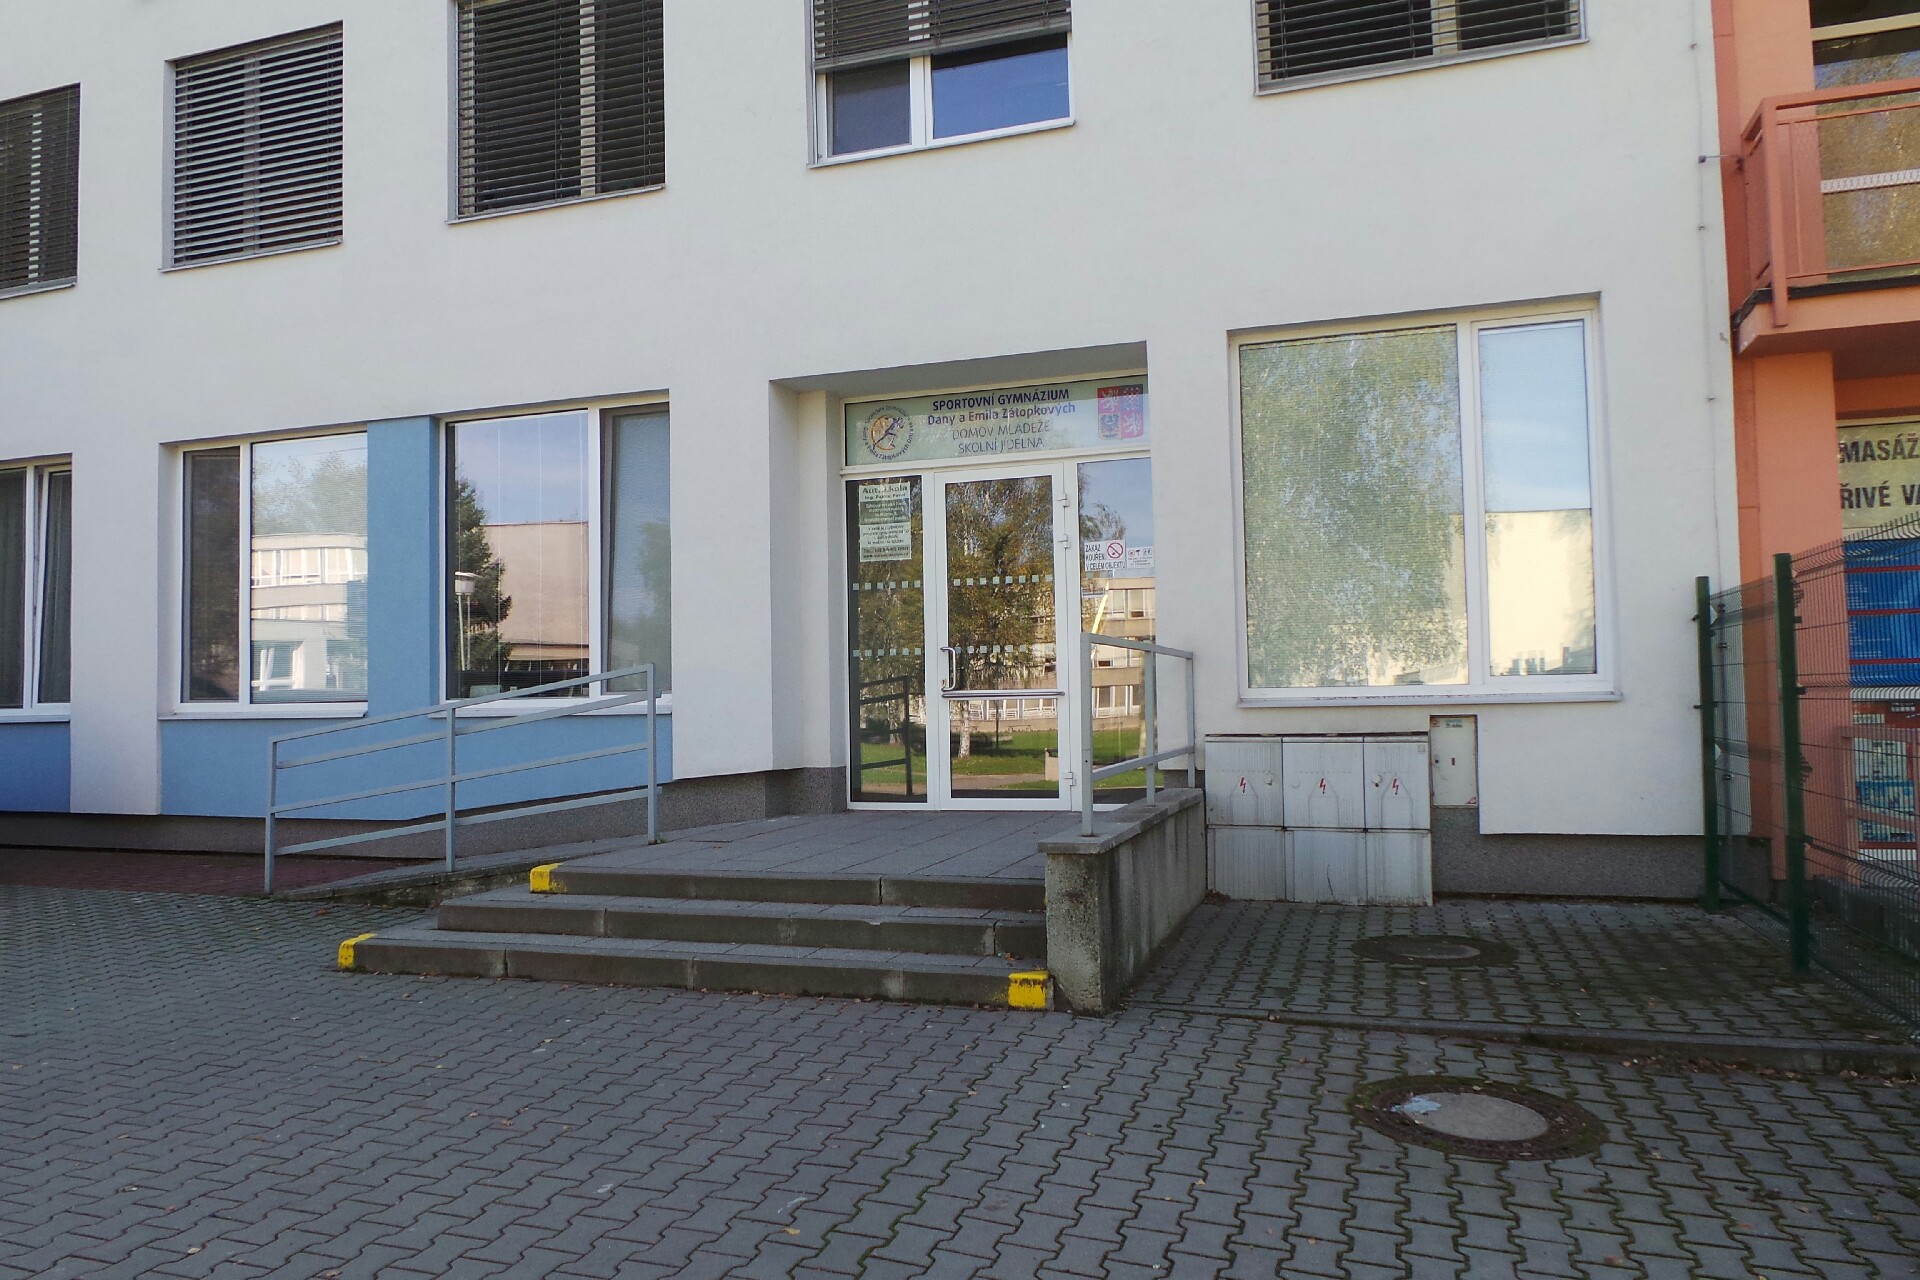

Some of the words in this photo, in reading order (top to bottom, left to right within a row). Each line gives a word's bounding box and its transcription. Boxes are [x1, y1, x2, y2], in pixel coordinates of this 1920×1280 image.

[933, 393, 995, 411] SPORTOVNÍ
[998, 388, 1069, 405] GYMNÁZIUM
[928, 415, 955, 426] Dany
[959, 414, 966, 423] a
[968, 408, 998, 422] Emila
[1002, 402, 1075, 419] Zátopkových
[952, 426, 994, 440] DOMOV
